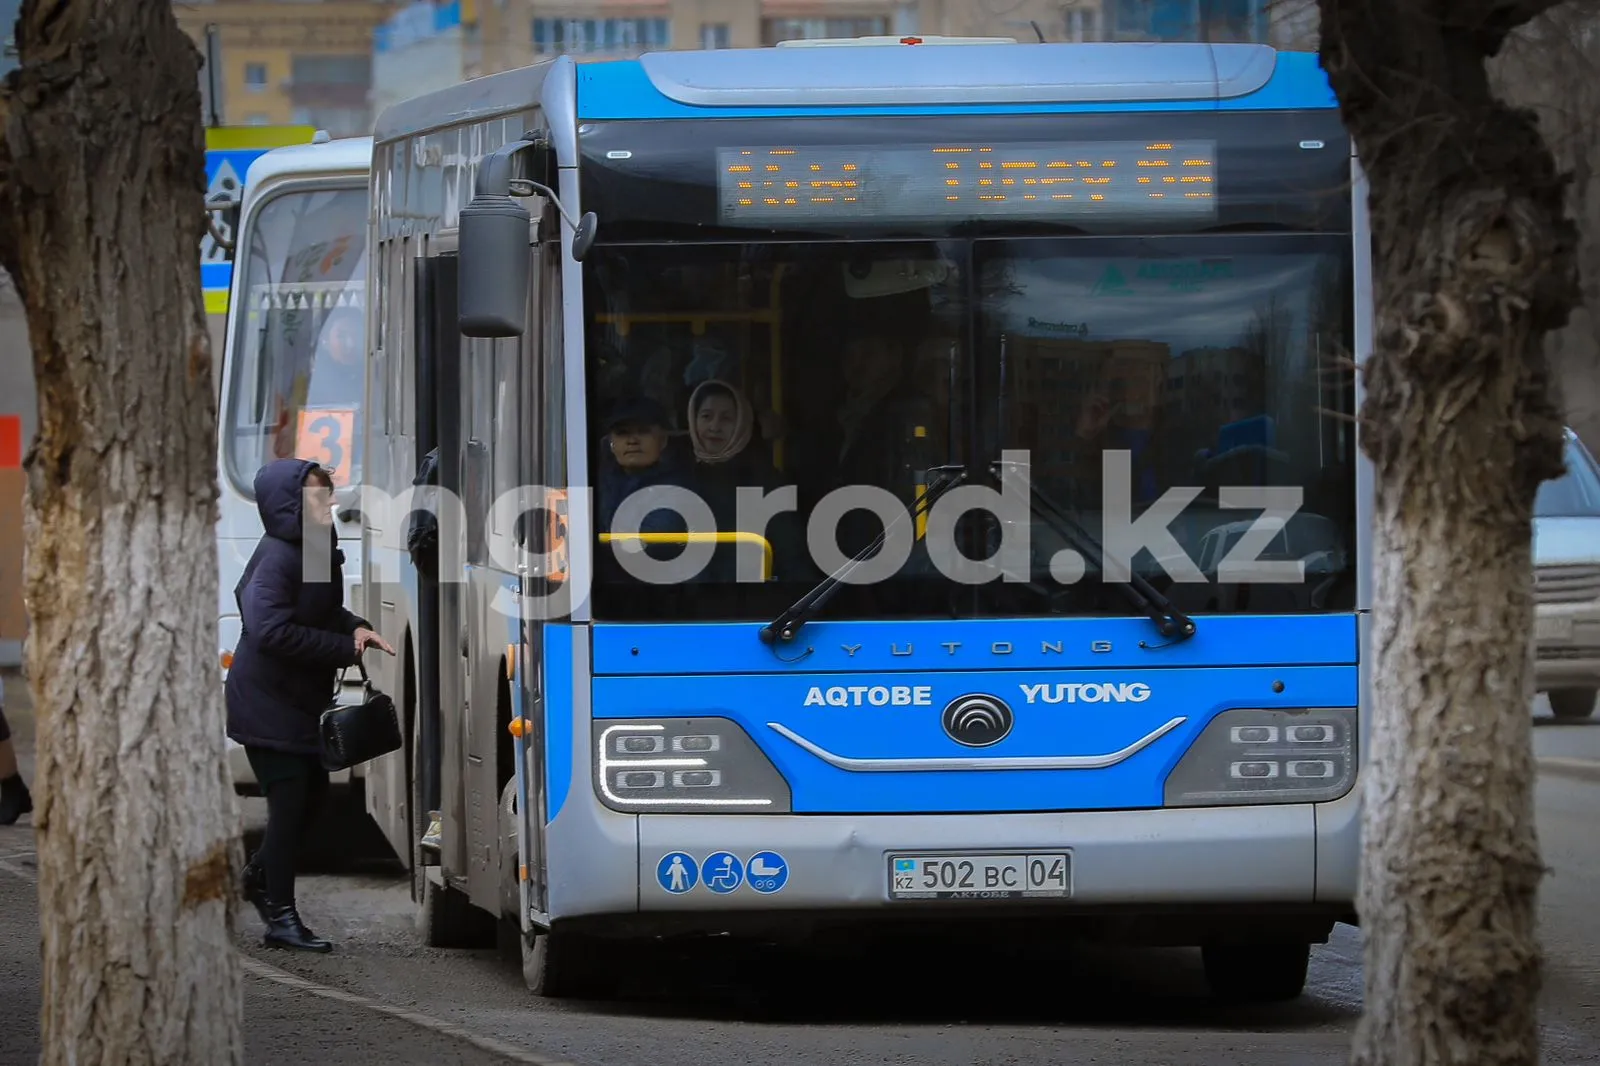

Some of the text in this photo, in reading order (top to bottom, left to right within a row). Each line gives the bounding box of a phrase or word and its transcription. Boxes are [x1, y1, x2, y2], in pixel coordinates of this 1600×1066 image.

[308, 415, 343, 470] 3
[840, 640, 1113, 656] YUTONG
[804, 685, 932, 708] AQTOBE
[1019, 683, 1151, 704] YUTONG
[895, 859, 1065, 889] KZ 502 BC 04
